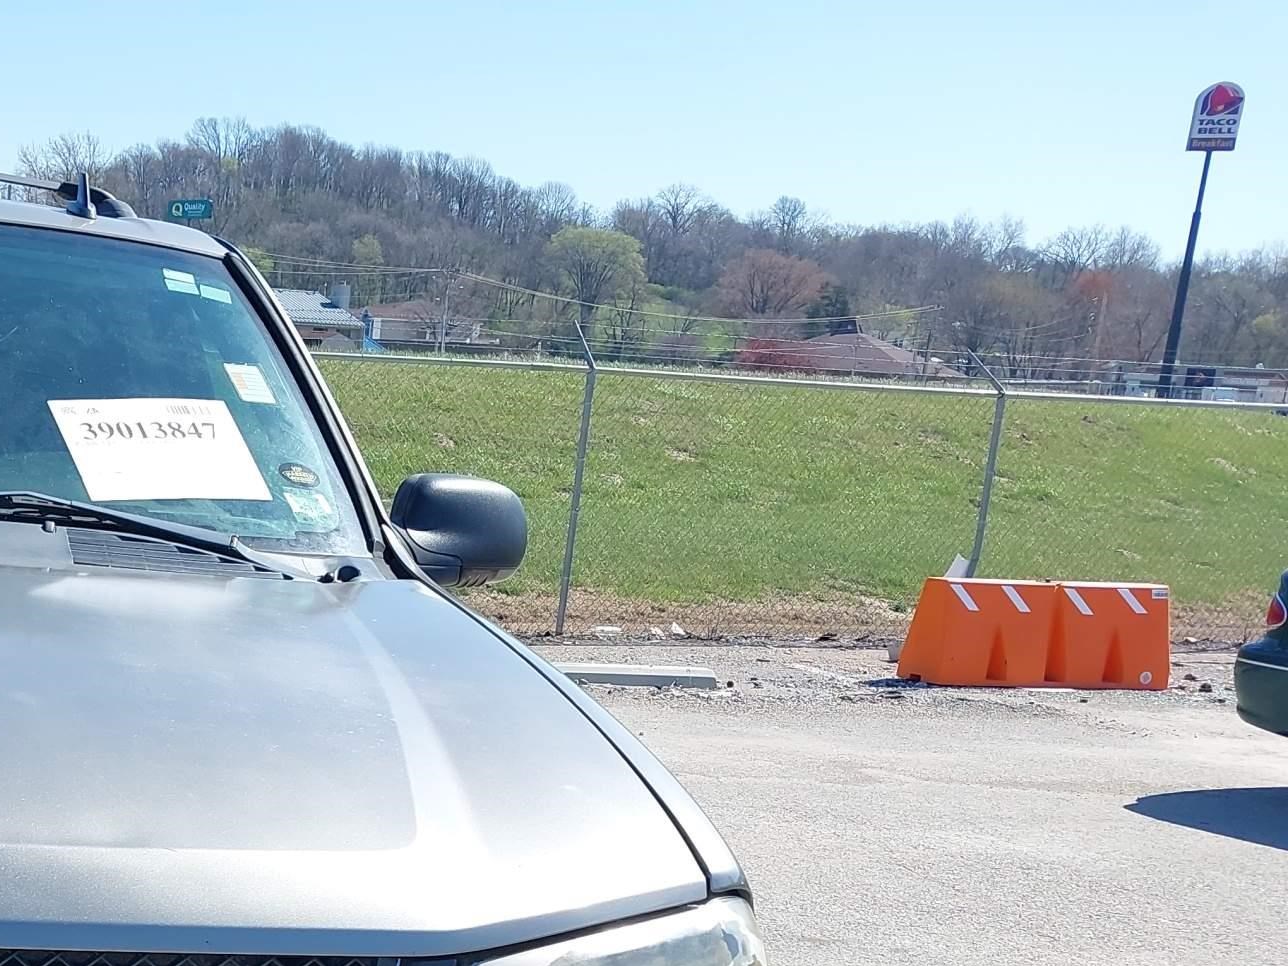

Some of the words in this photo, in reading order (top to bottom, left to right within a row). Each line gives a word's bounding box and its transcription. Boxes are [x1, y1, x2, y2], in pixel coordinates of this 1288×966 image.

[1198, 118, 1237, 126] TACO
[184, 202, 205, 211] Quality
[80, 421, 216, 440] 39013847
